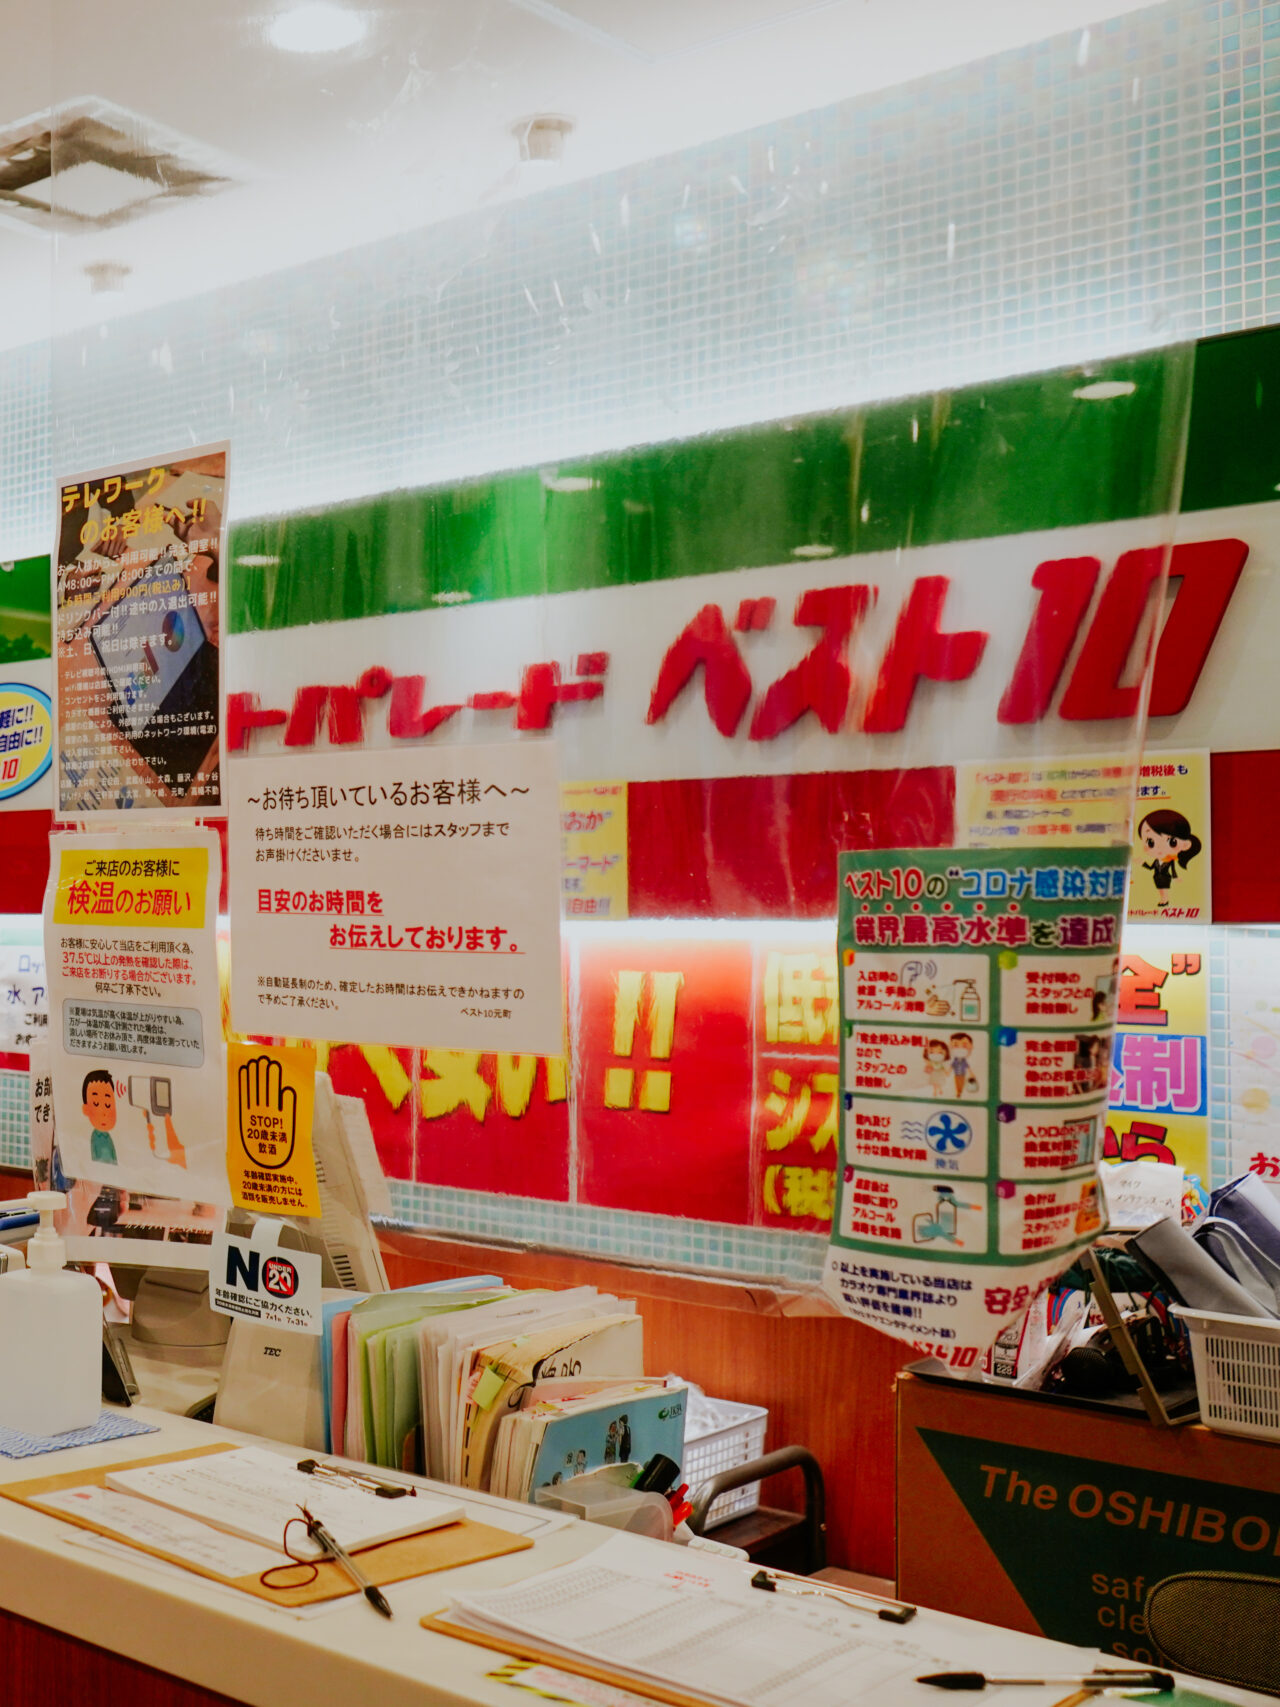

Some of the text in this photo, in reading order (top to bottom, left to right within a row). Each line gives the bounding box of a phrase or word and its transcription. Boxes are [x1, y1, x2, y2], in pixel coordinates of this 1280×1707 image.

[61, 466, 167, 513] テレワーク
[645, 538, 1250, 741] ベスト10
[255, 821, 510, 842] 待ち時間をご確認いただく場合にはスタッフまで
[255, 848, 360, 863] お声掛けくださいませ。
[83, 857, 181, 879] ご来店のお客様に
[67, 880, 191, 916] 検温のお願い
[257, 888, 384, 914] 目安のお時間を
[1160, 907, 1200, 919] ベスト10
[329, 923, 519, 953] お伝えしております。
[853, 915, 1116, 947] 業界最高水準を達成
[62, 966, 196, 986] ご来店をお断りする場合がございます。
[95, 982, 162, 997] 何卒ご了承下さい。
[257, 995, 339, 1011] で予めご了承ください。
[460, 1007, 512, 1020] ベスト10元町
[249, 1114, 284, 1130] STOP!
[247, 1128, 288, 1144] 20歳未満
[258, 1142, 277, 1155] 飲酒
[243, 1169, 299, 1185] 年齢確認実施中。
[242, 1180, 303, 1197] 20歳未満の方には
[241, 1191, 309, 1208] 酒類を販売しません。
[268, 1262, 292, 1273] UNDER
[267, 1268, 292, 1292] 20
[215, 1287, 313, 1318] 年齢確認にご協力ください。
[263, 1346, 282, 1357] TEC
[979, 1463, 1280, 1558] The OSHIBO
[1091, 1573, 1154, 1600] saf
